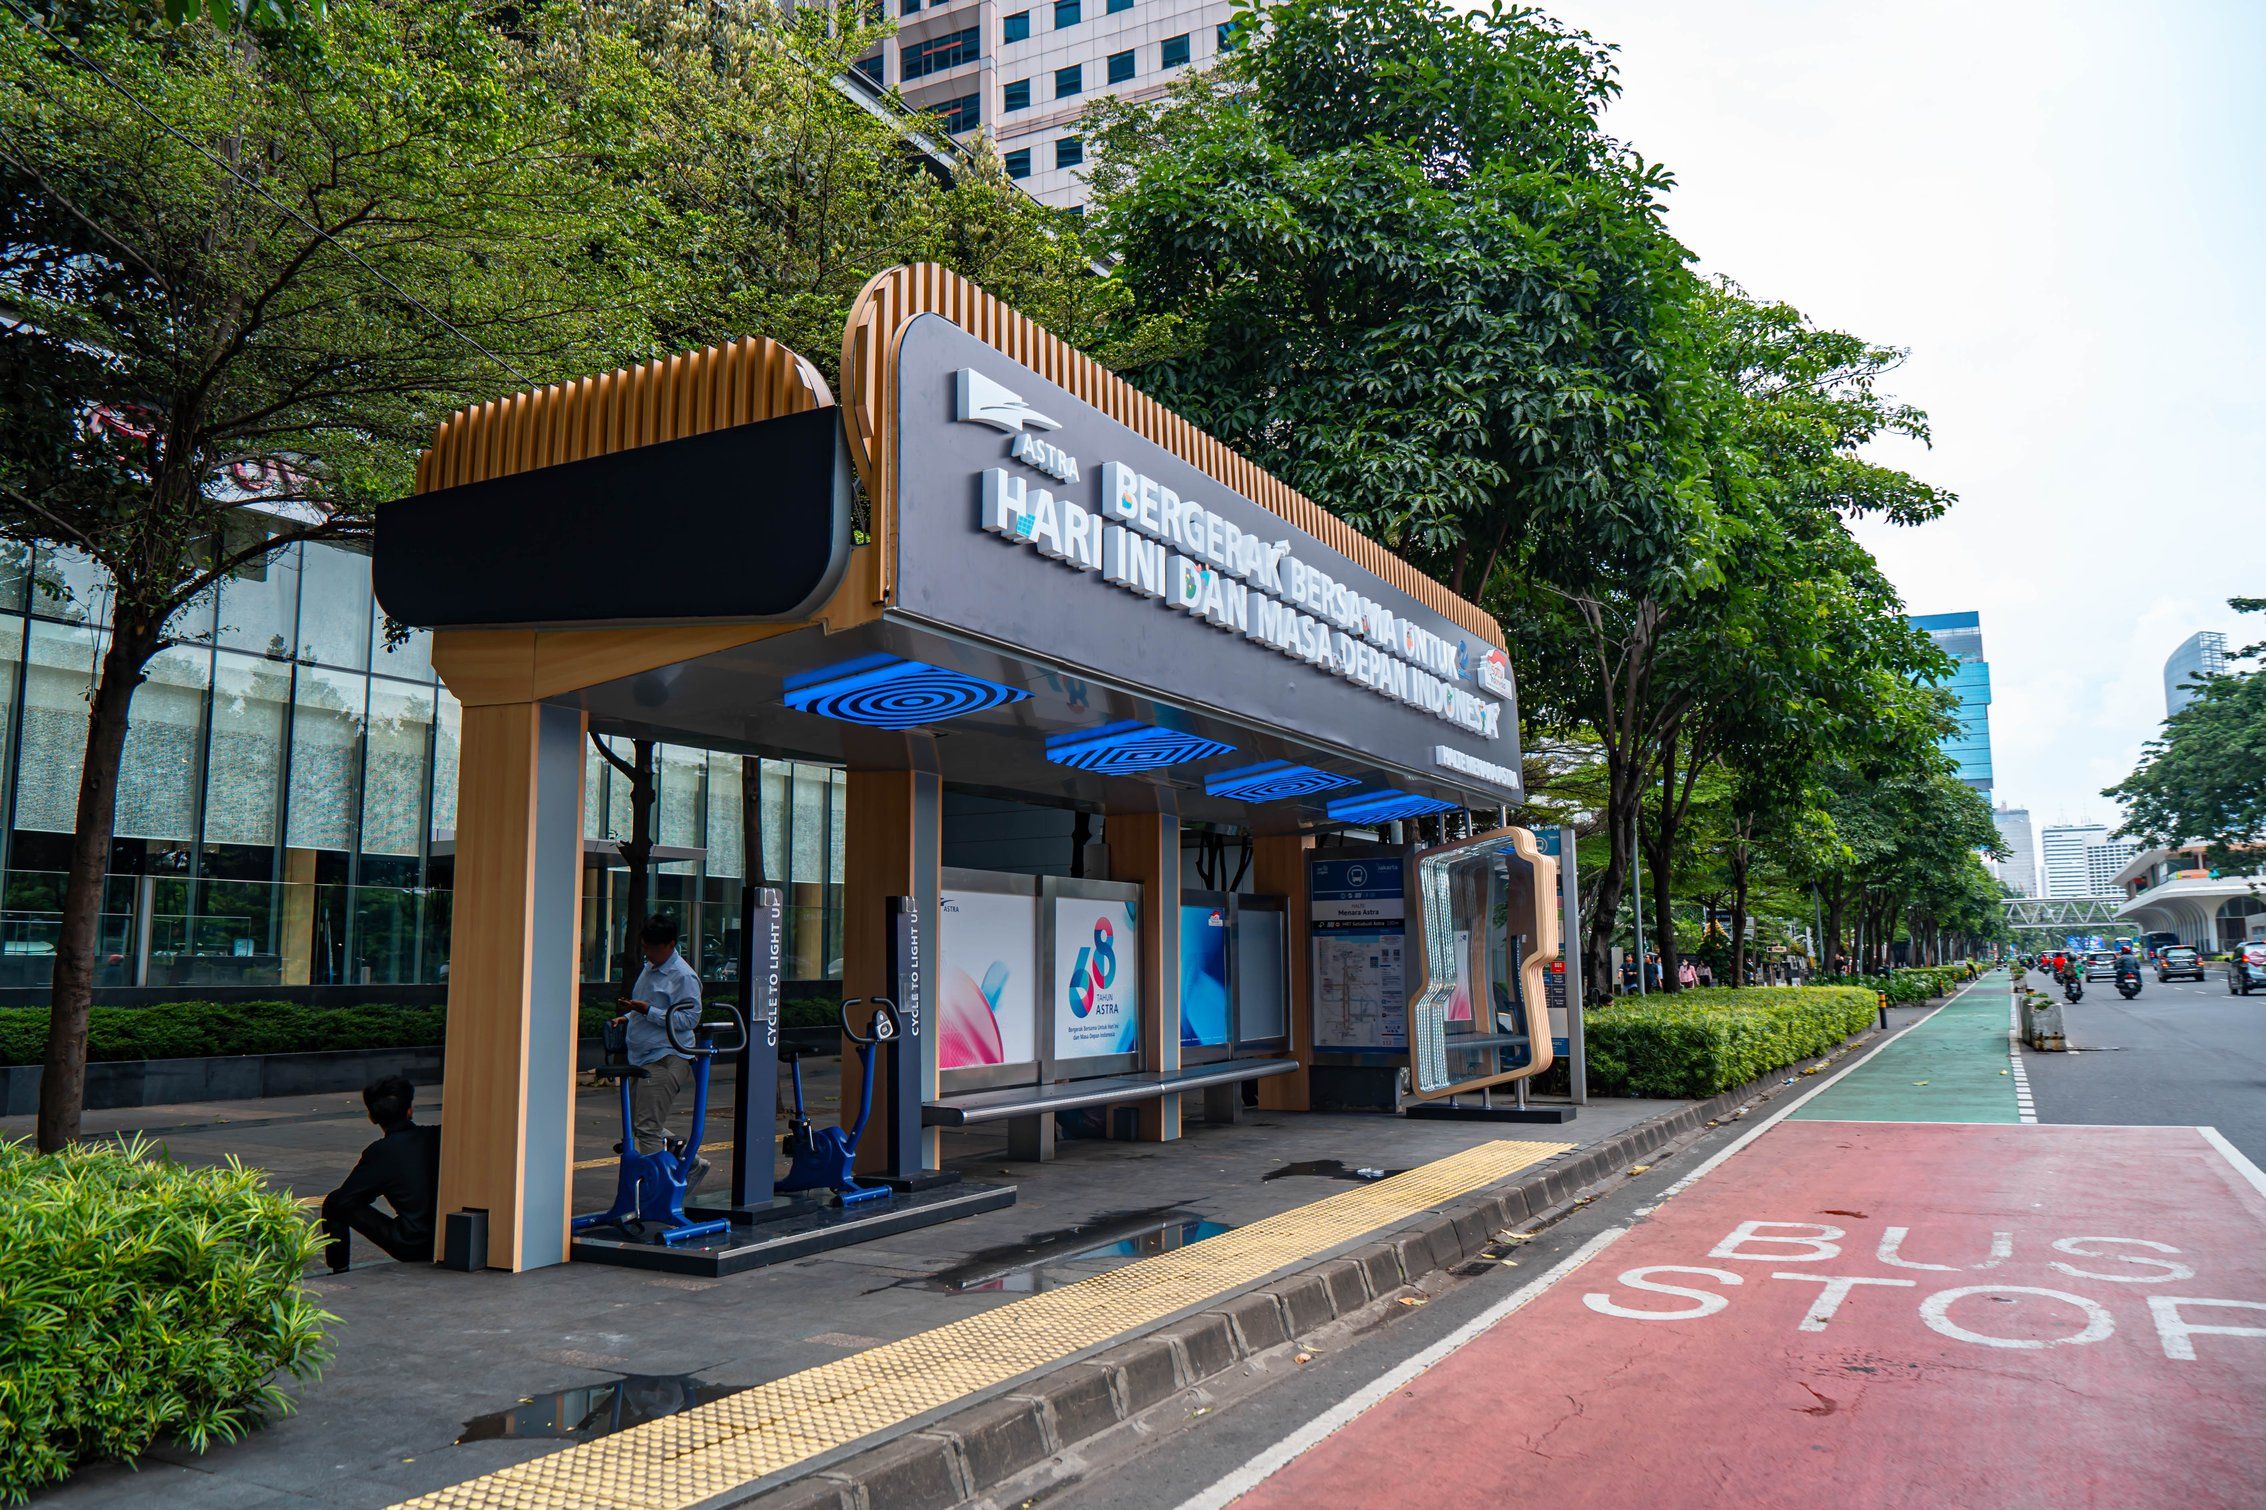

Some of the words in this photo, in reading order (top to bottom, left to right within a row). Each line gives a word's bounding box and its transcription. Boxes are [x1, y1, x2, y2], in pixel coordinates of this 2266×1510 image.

[1012, 433, 1080, 483] ASTRA
[1102, 461, 1285, 595] BERGERAK
[1280, 556, 1398, 651] BERSAMA
[1395, 618, 1459, 681] UNTUK
[982, 468, 1102, 572] HARI
[1103, 525, 1165, 598] INI
[1166, 555, 1247, 632] DAN
[1246, 592, 1333, 670] MASA
[1332, 632, 1407, 700] DEPAN
[1406, 666, 1500, 739] INDONESIA
[943, 905, 960, 913] ASTRA
[769, 923, 780, 969] LIGHT
[910, 927, 919, 968] LIGHT
[1069, 916, 1117, 1018] 68
[769, 973, 779, 994] TO
[911, 971, 919, 991] TO
[1096, 993, 1114, 1001] TAHUN
[767, 998, 778, 1046] CYCLE
[911, 993, 919, 1036] CYCLE
[1095, 1003, 1119, 1015] ASTRA
[1707, 1221, 2195, 1283] BUS
